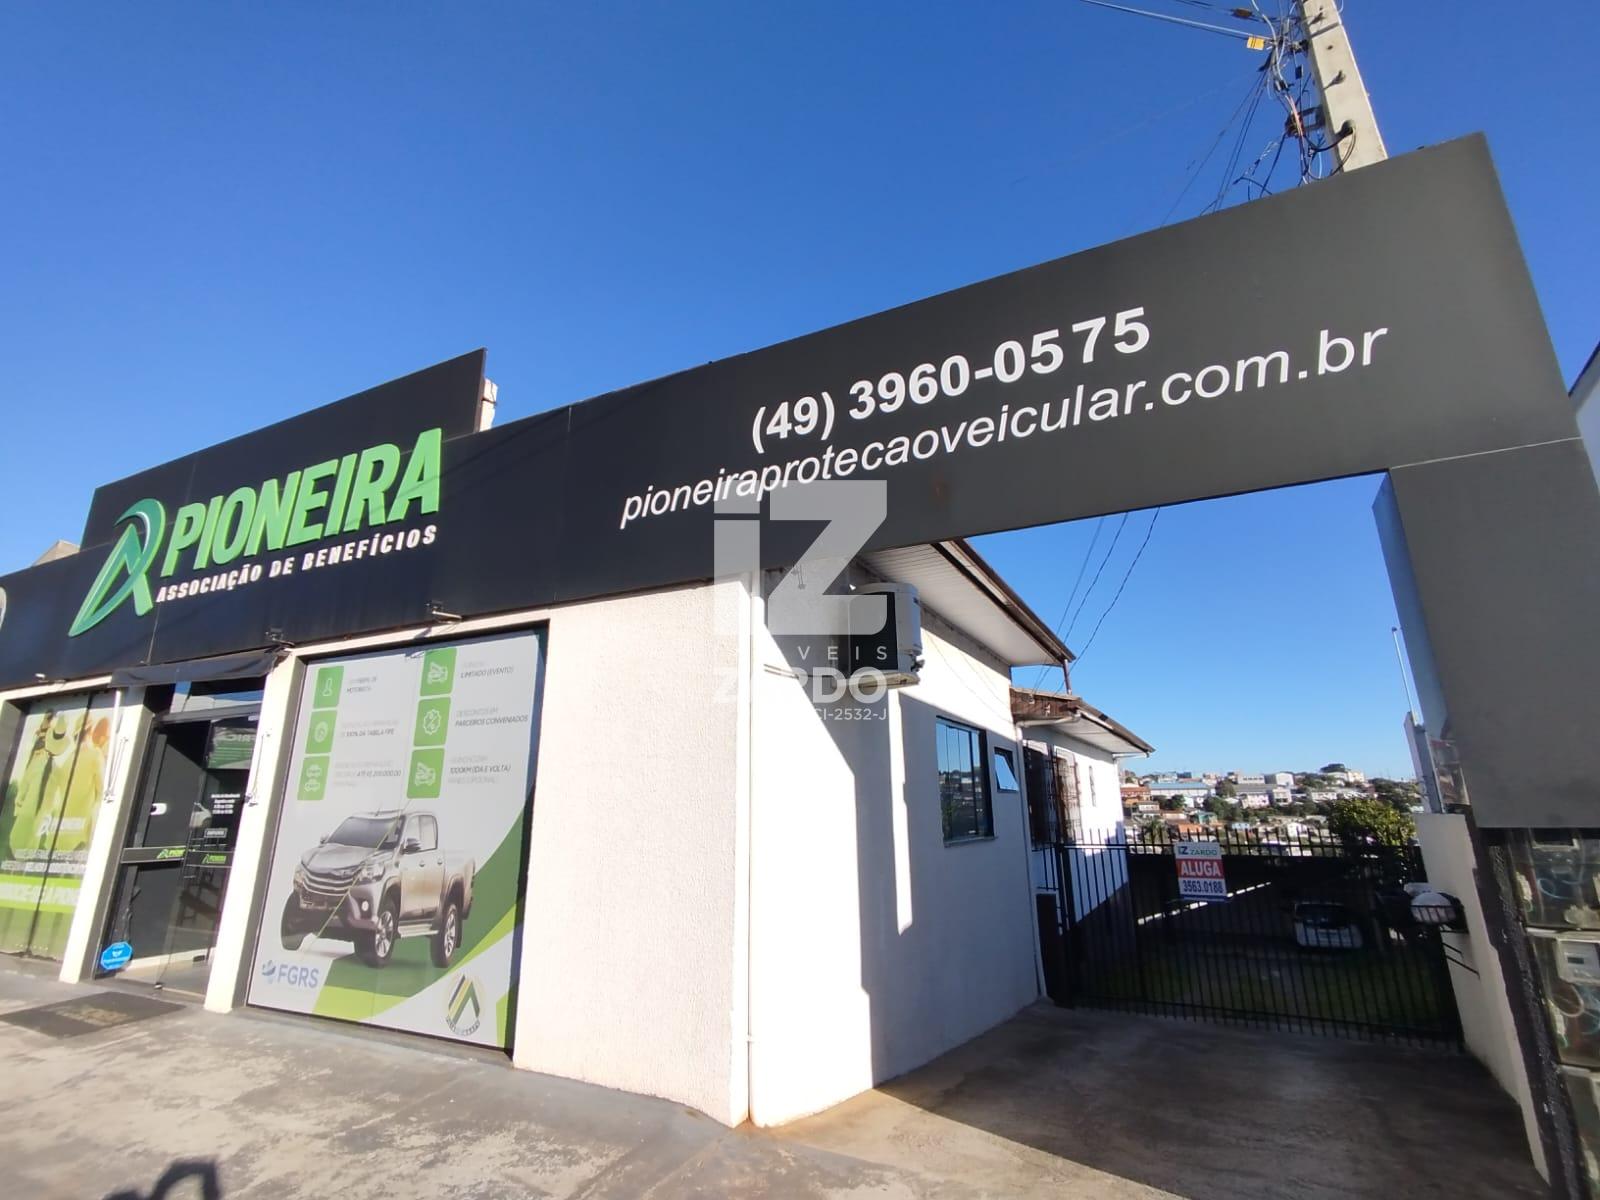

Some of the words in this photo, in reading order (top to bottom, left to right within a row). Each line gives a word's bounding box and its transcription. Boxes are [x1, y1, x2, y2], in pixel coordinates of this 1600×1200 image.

[618, 324, 1389, 529] pioneiraprotecaoveicular.com.br
[751, 391, 835, 454] (49)
[848, 305, 1152, 421] 3960-0575
[160, 427, 443, 578] PIONEIRA
[155, 563, 262, 603] ASSOCIAÇÃO
[269, 556, 293, 577] DE
[301, 522, 438, 571] BENEFÍCIOS
[1181, 861, 1222, 877] ALUGA
[277, 964, 319, 989] FGRS
